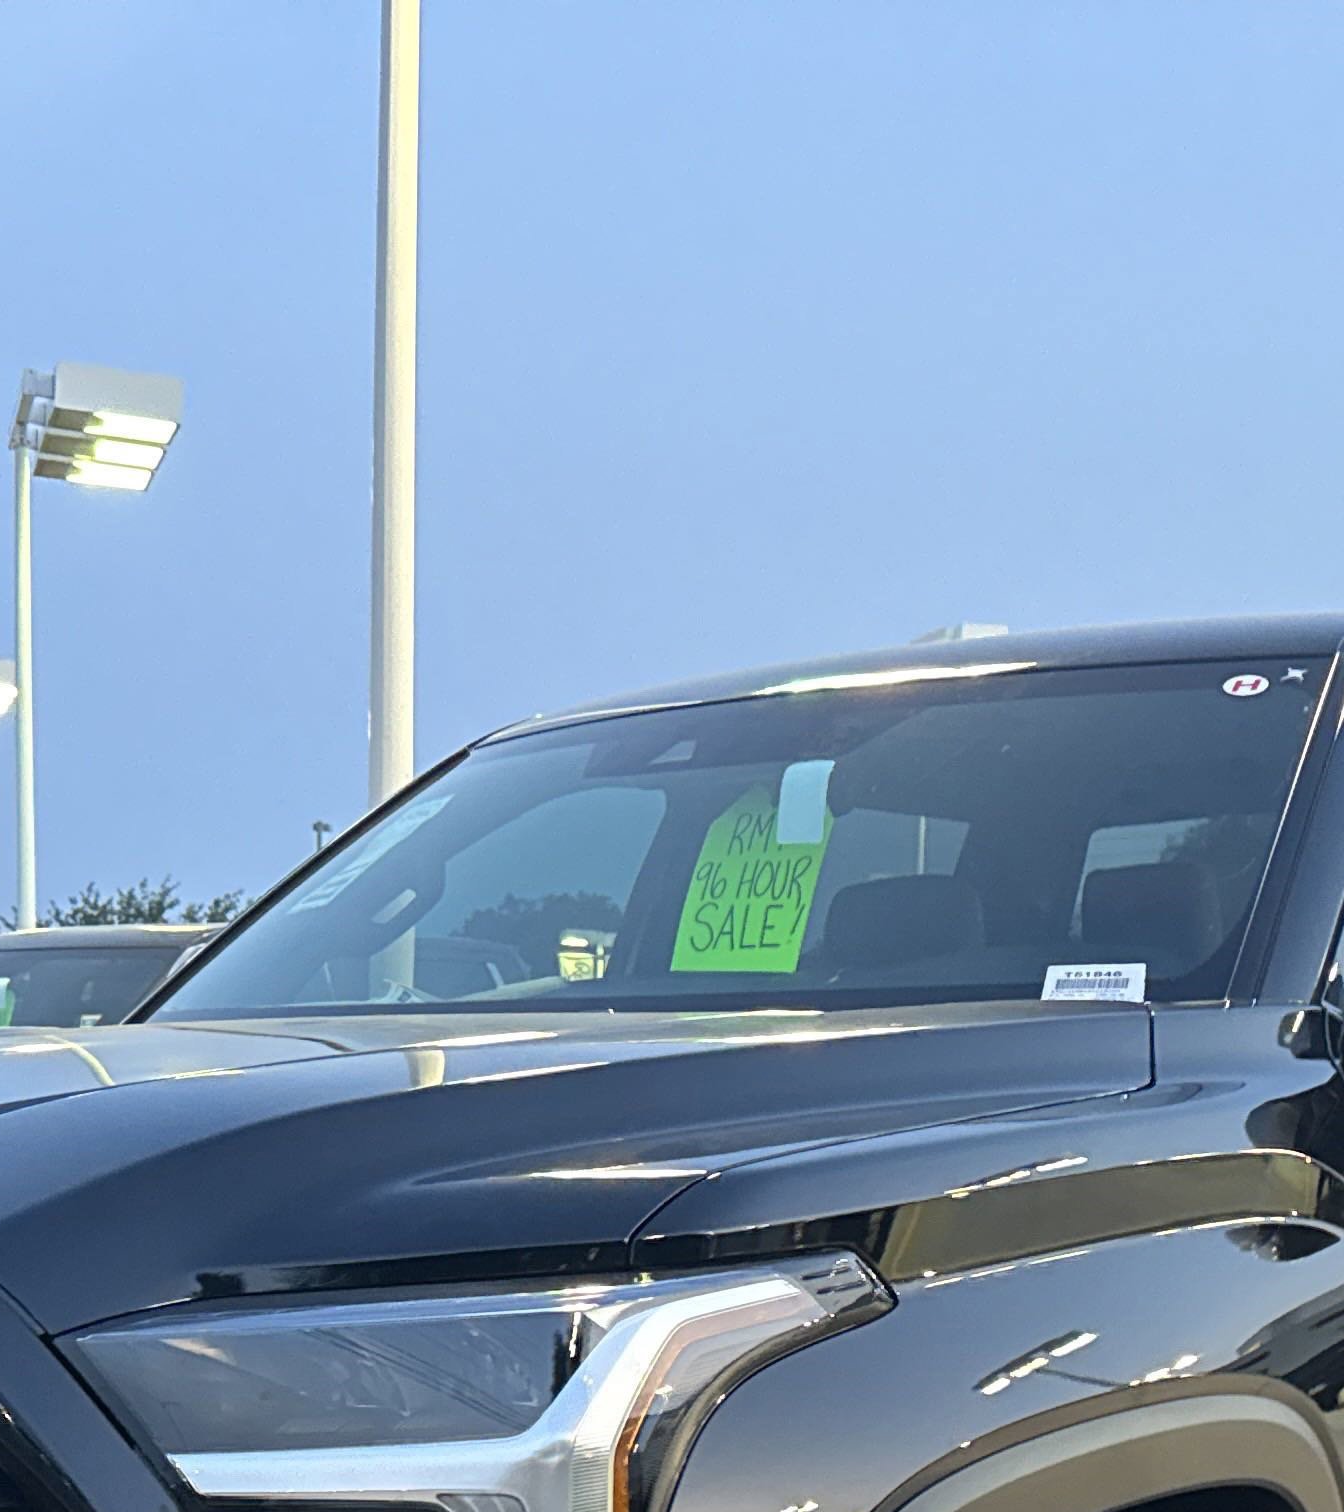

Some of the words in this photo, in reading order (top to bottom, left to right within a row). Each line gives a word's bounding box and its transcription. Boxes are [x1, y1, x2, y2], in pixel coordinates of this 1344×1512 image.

[696, 860, 728, 902] 96
[735, 854, 813, 909] HOUR
[689, 901, 806, 953] SALE!
